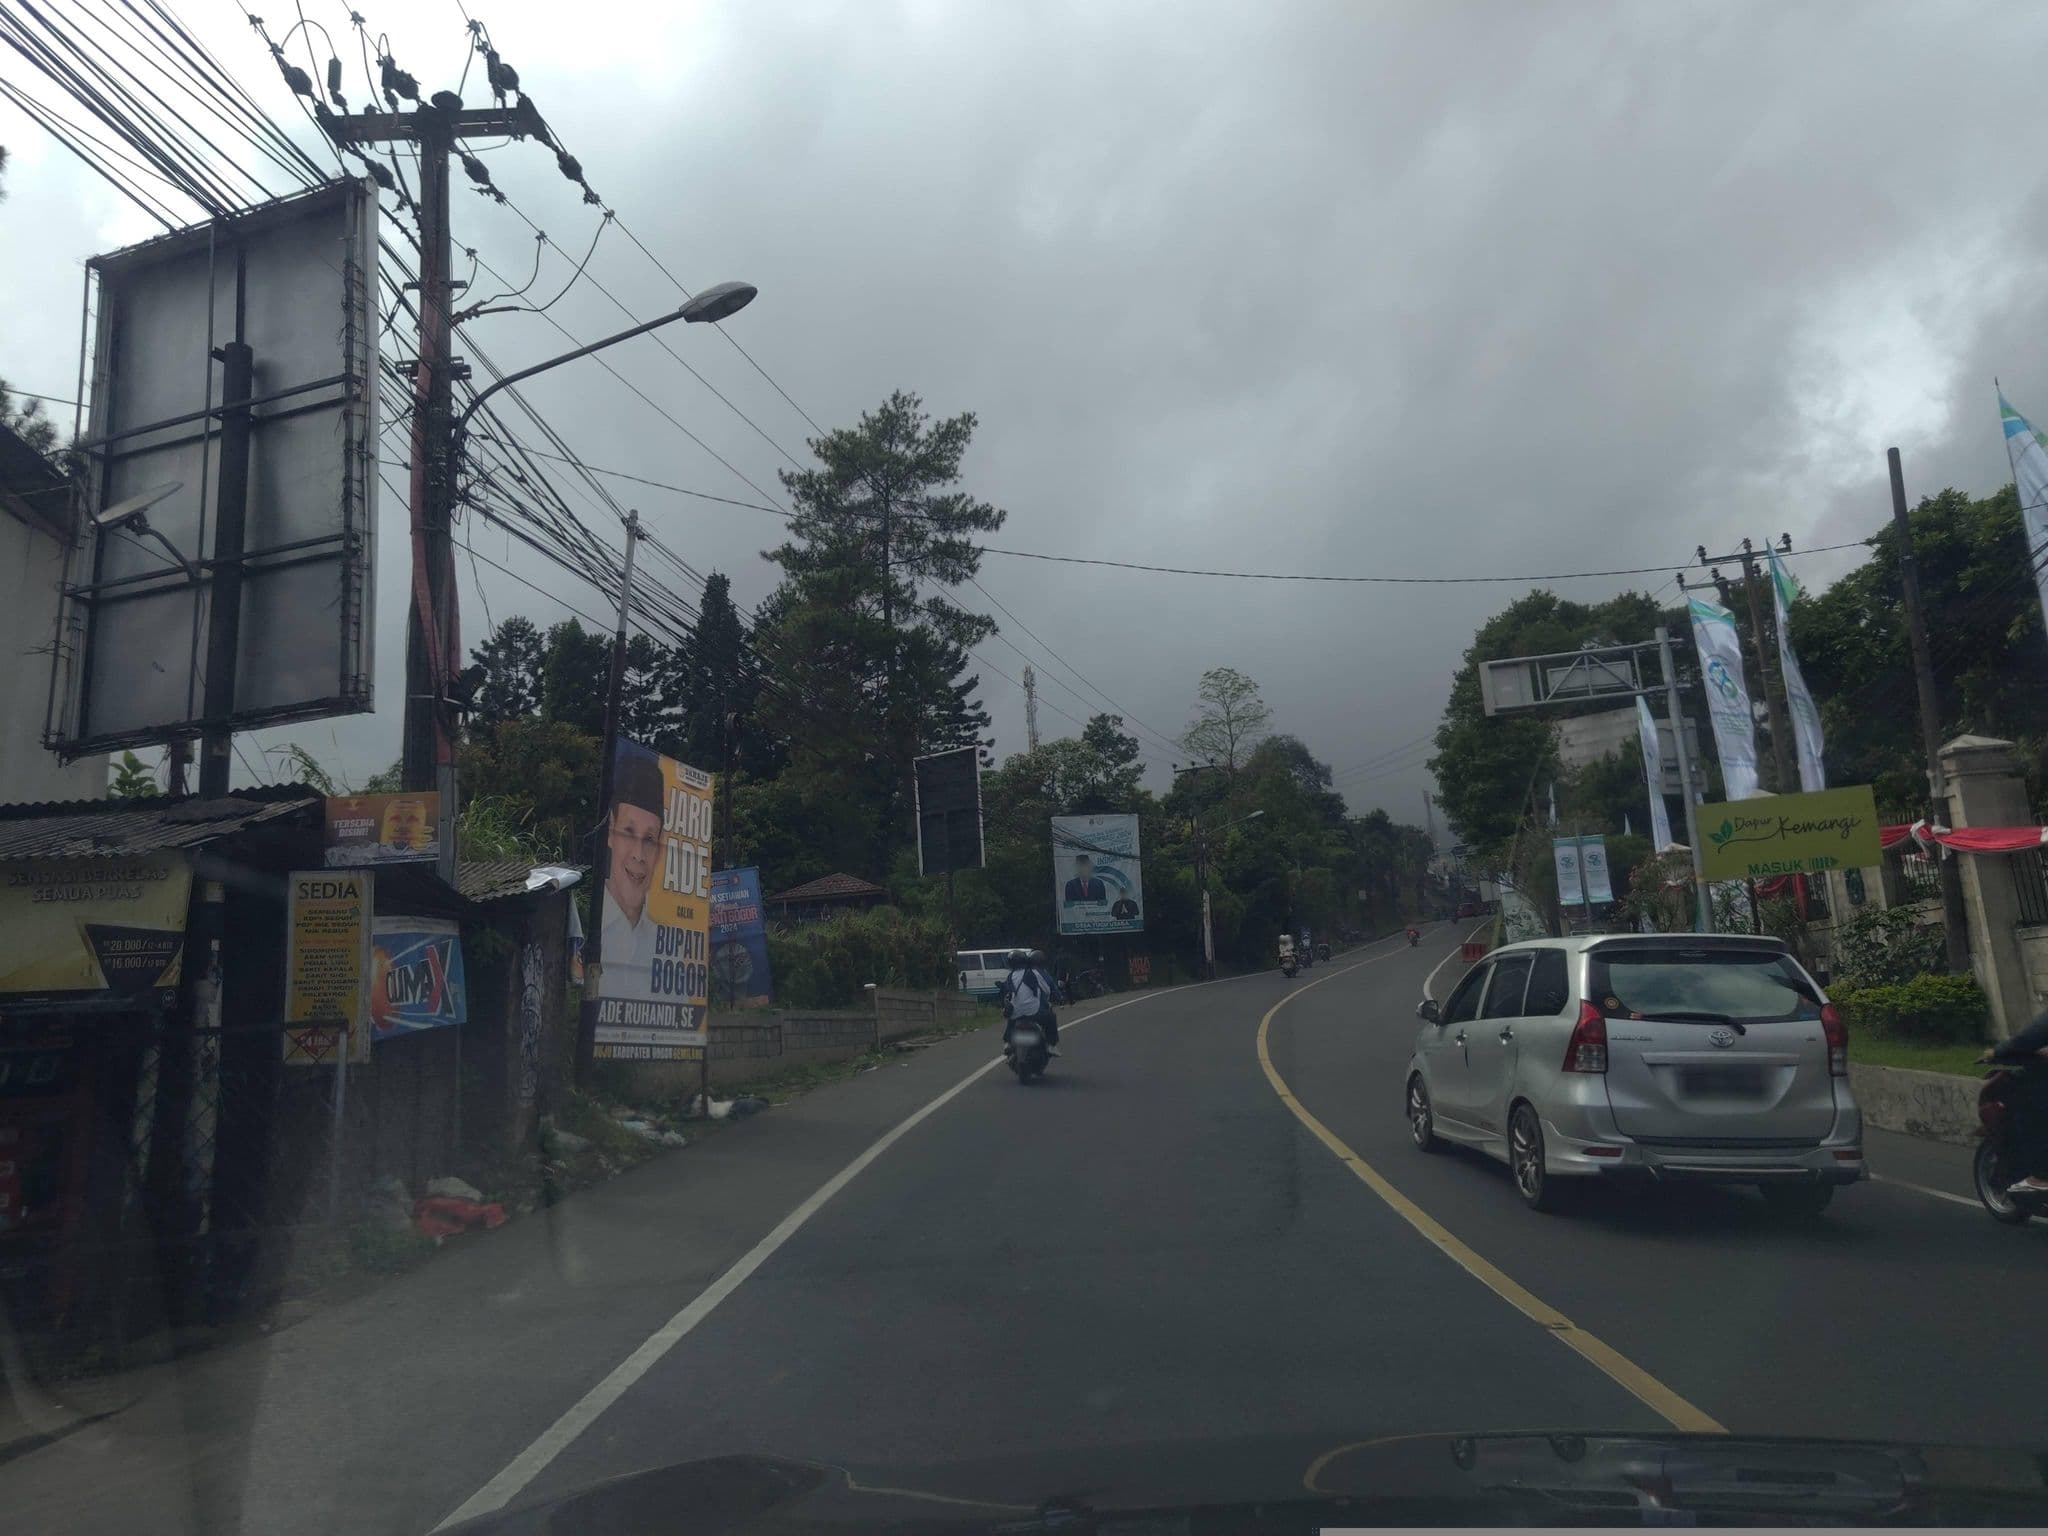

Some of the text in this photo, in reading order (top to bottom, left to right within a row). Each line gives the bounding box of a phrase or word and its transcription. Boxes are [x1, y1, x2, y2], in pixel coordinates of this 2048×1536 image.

[334, 818, 375, 829] TERSEDIA
[663, 786, 712, 843] JARO
[1734, 815, 1862, 840] Dapur Kemangi
[663, 837, 709, 899] ADE
[1747, 859, 1803, 875] MASUK
[32, 886, 93, 902] SEMUA
[298, 882, 359, 900] SEDIA
[728, 907, 758, 923] BOGOR
[655, 924, 704, 961] BUPATI
[651, 957, 706, 997] BOGOR
[598, 1000, 695, 1029] ADE RUHANDI, SE
